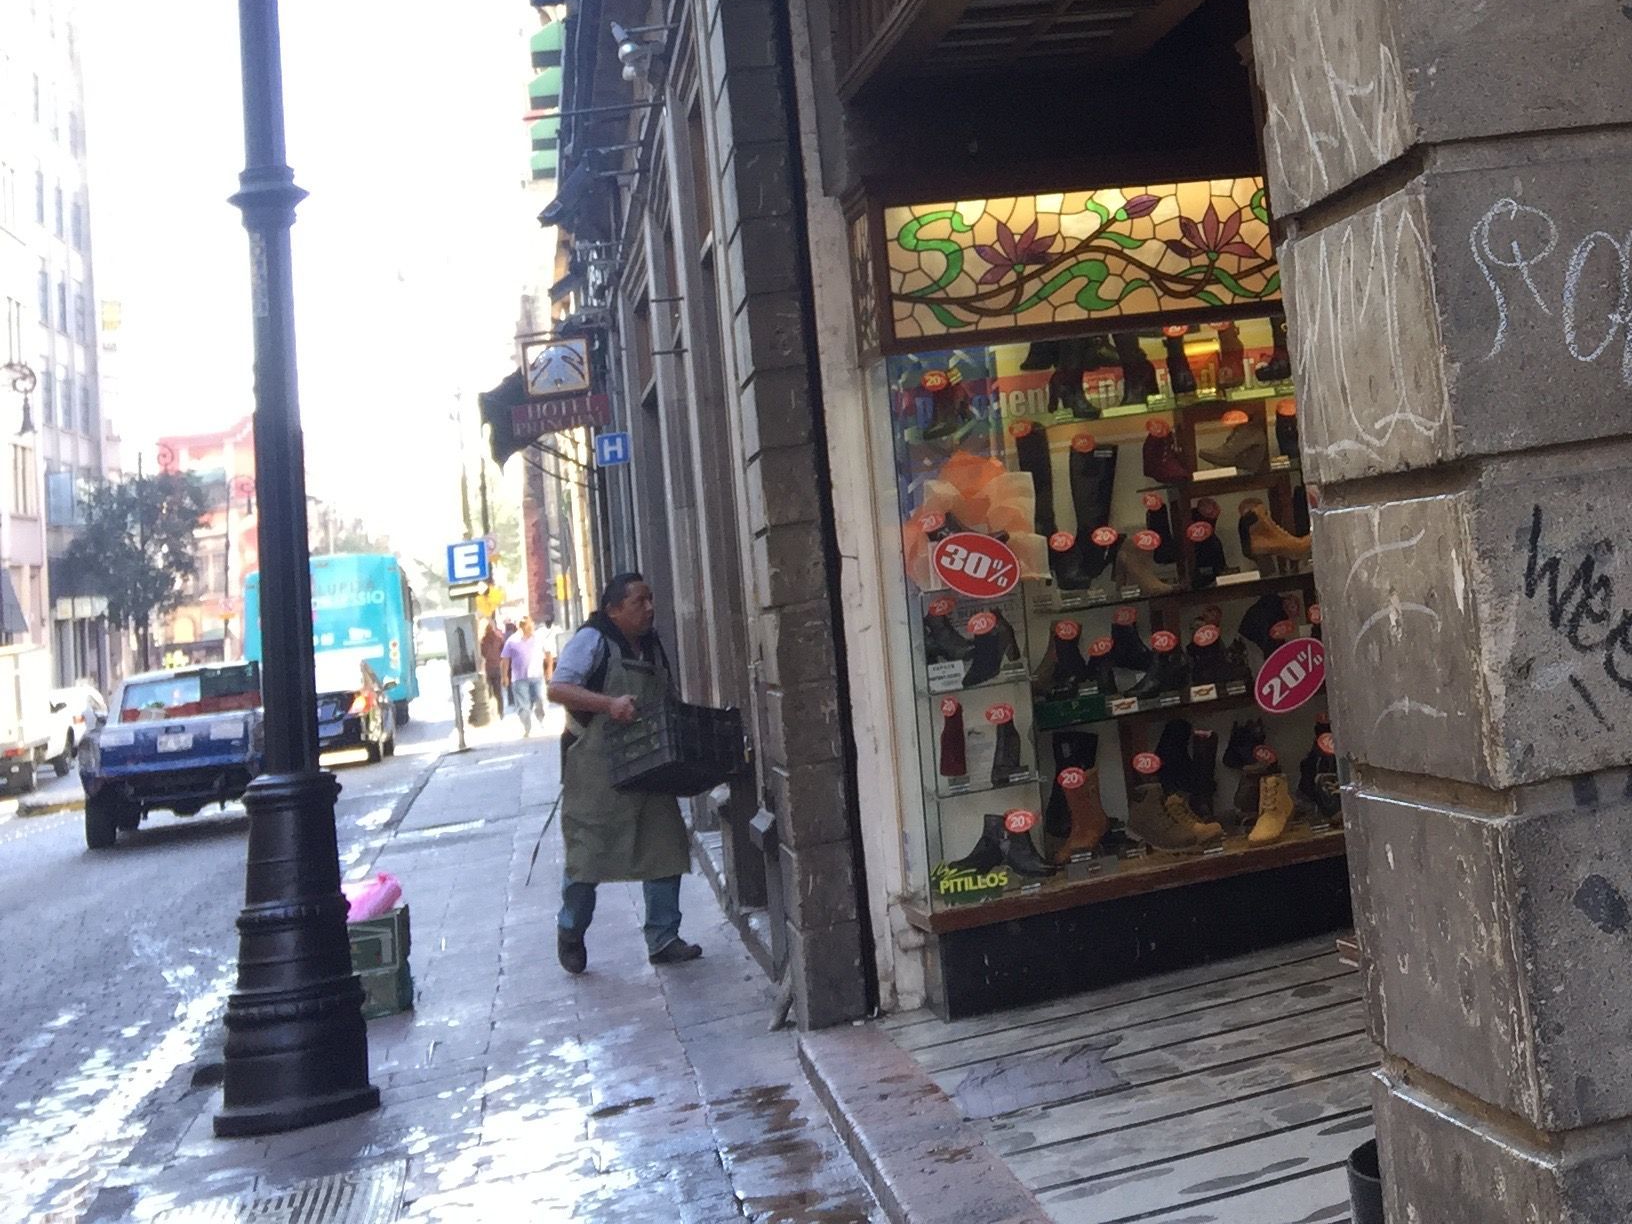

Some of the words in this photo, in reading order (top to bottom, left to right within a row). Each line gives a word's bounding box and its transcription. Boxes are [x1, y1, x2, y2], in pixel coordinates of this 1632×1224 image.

[603, 438, 623, 462] H
[453, 544, 481, 578] E
[940, 544, 1013, 588] 30%
[1262, 644, 1323, 707] 20%
[940, 871, 1009, 895] PITILLOS
